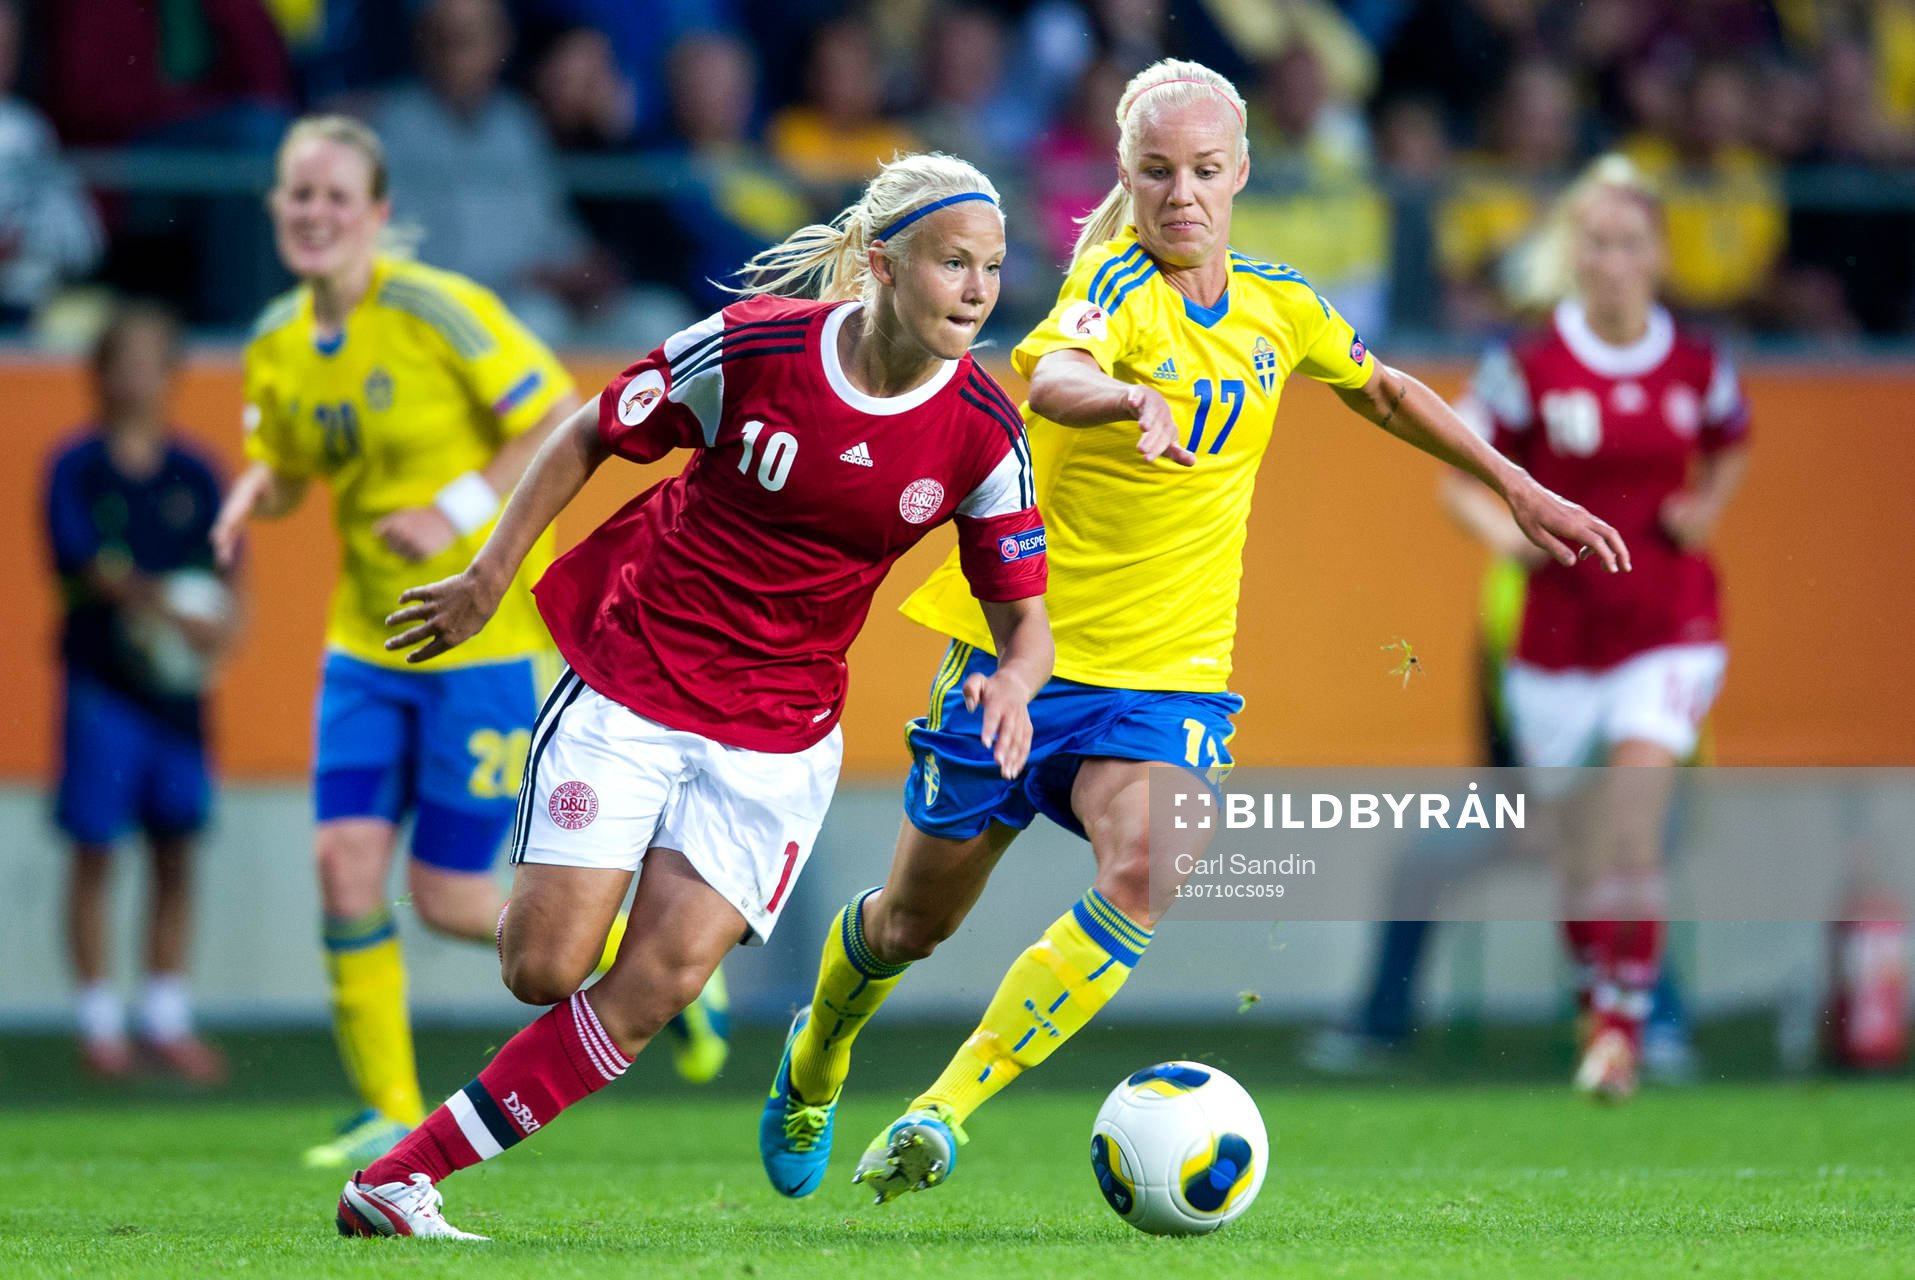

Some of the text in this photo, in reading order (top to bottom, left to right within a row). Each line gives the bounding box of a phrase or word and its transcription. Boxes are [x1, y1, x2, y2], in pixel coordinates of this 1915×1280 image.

[1187, 379, 1246, 455] 17
[737, 420, 799, 492] 10
[840, 453, 874, 468] adidas
[909, 492, 936, 507] DBU
[560, 797, 588, 812] DBU
[502, 1091, 541, 1134] DBU
